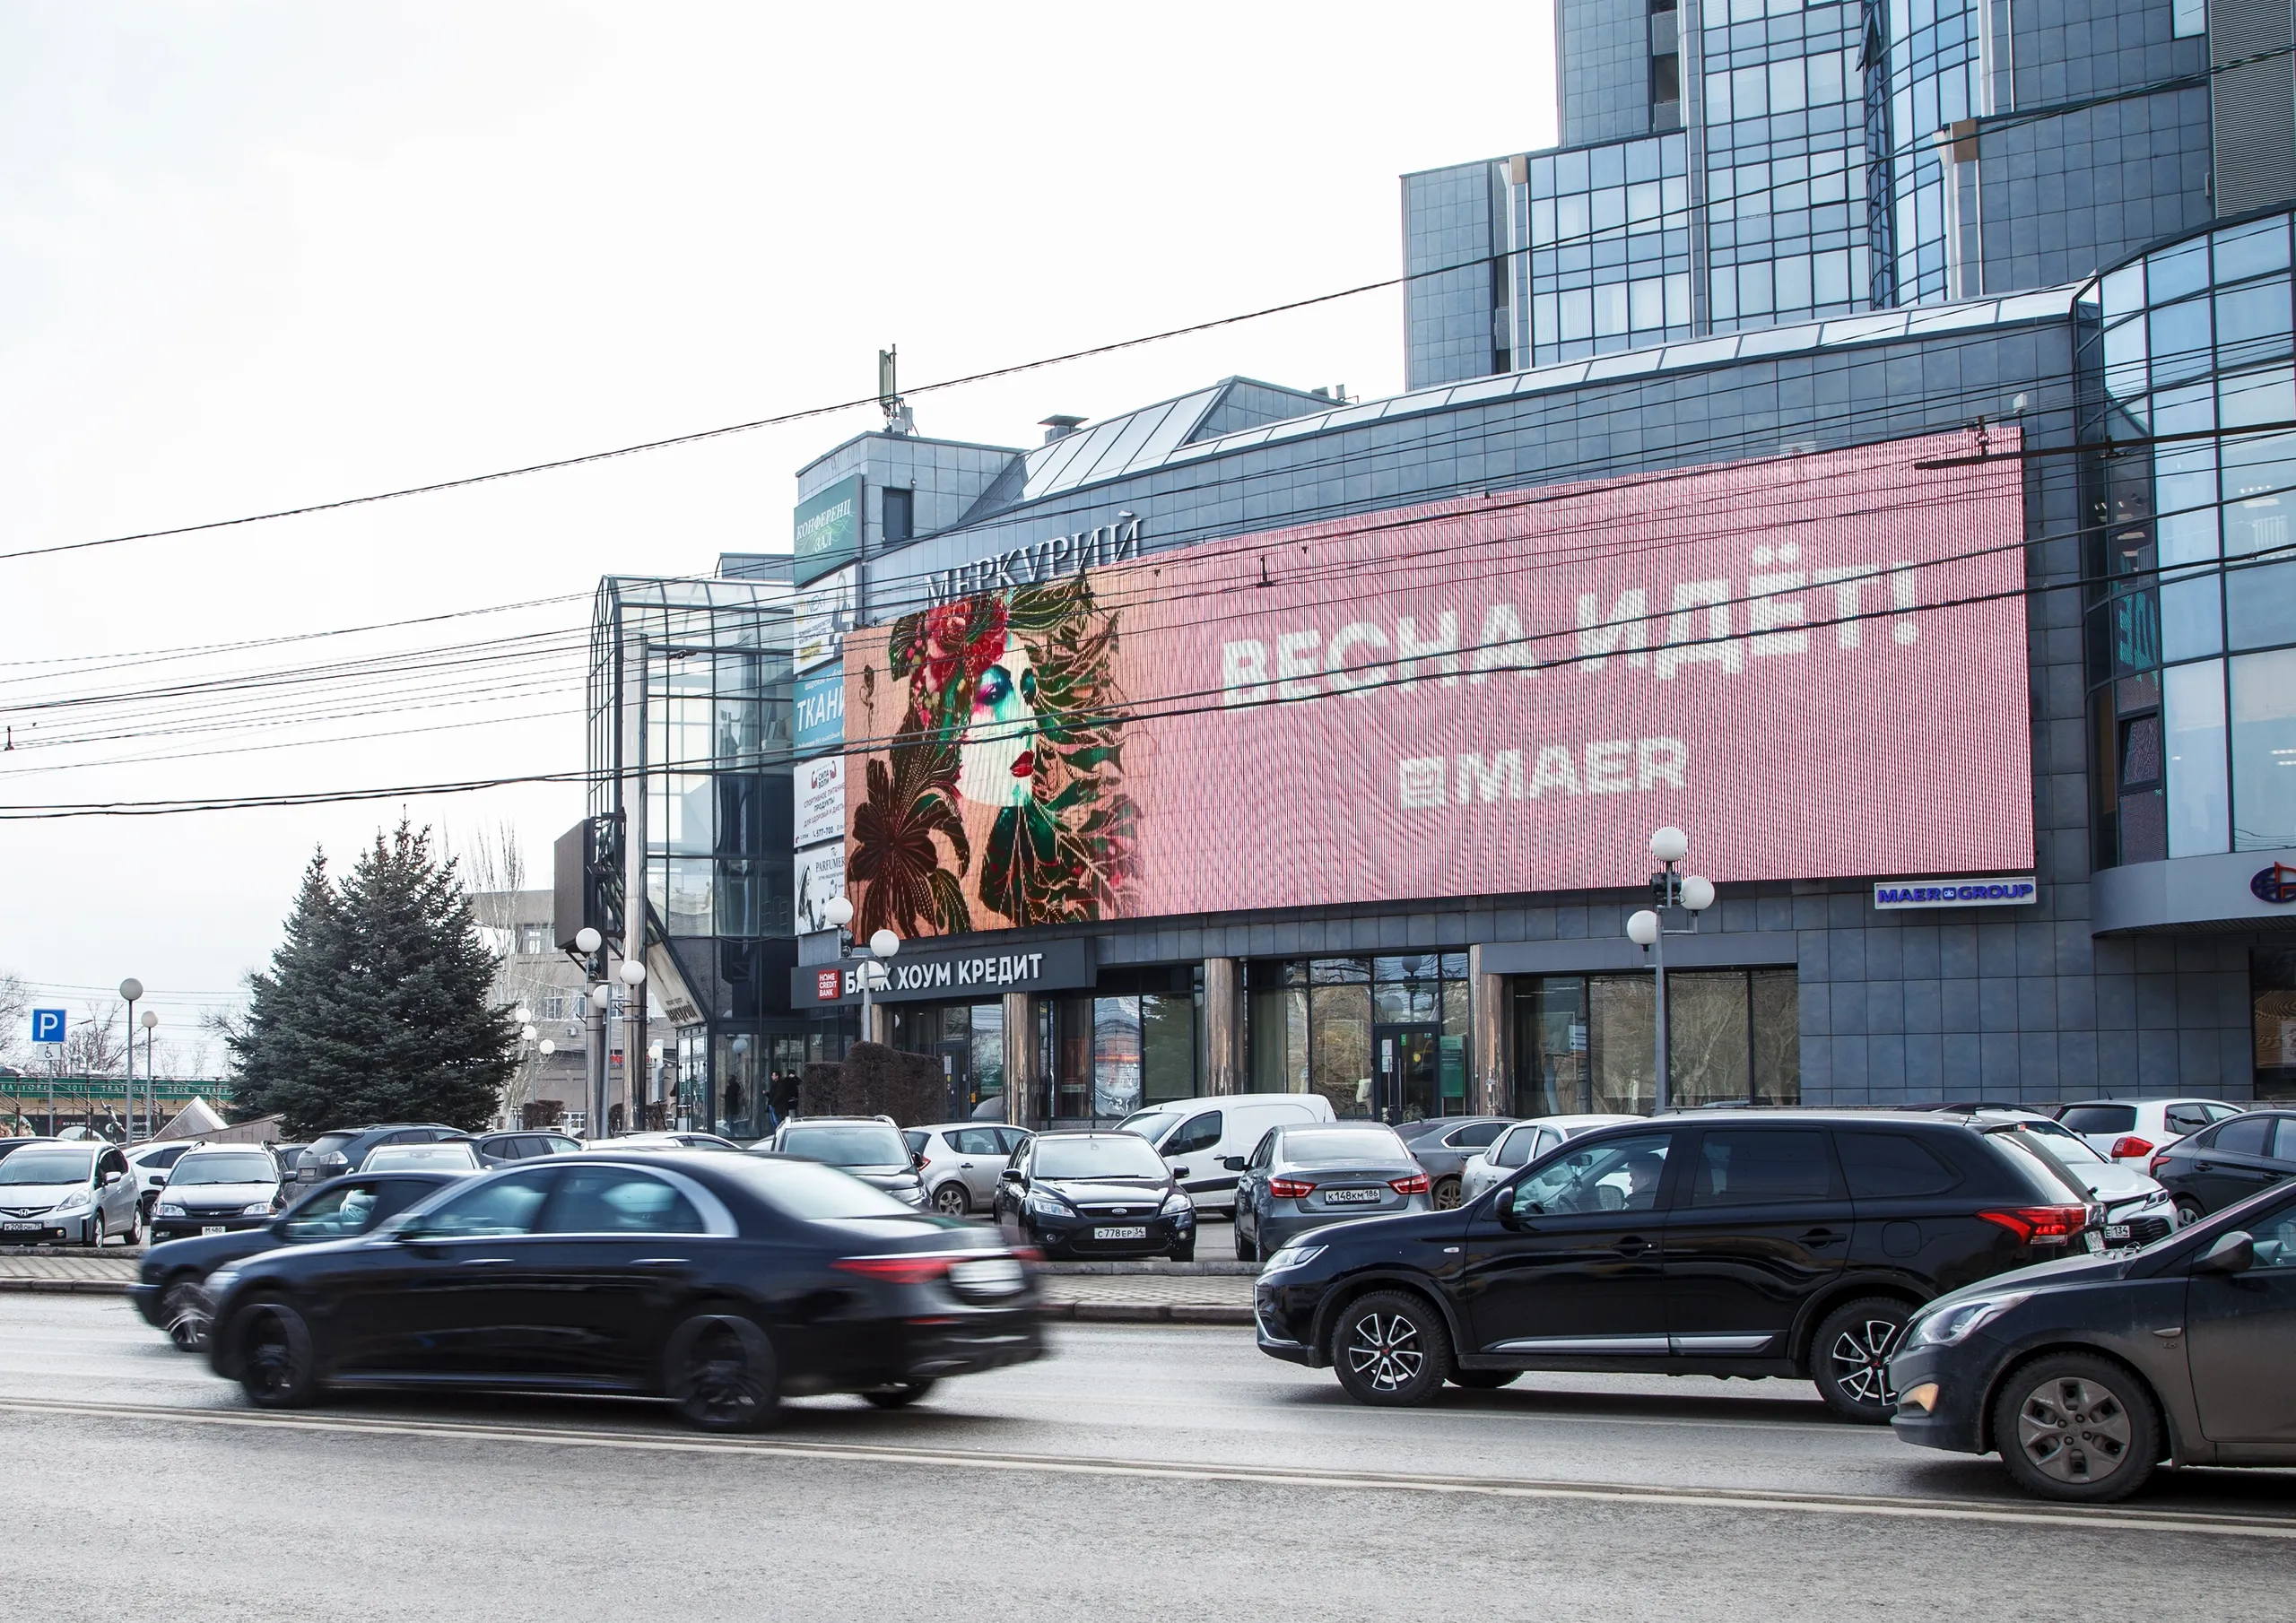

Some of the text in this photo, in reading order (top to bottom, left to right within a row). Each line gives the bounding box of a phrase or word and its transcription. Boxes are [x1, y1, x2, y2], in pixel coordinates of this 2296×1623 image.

[796, 499, 851, 541] КОНФЕРЕНЦ
[814, 531, 832, 553] ЗАЛ
[926, 510, 1142, 609] МЕРКУРИЙ
[1221, 542, 1919, 712] ВЕСНА ИДЁТ!
[1457, 736, 1686, 805] MAER
[813, 796, 836, 812] ПРОДУКТЫ
[815, 825, 834, 838] 577-700
[1877, 882, 2034, 904] MAER GROUP
[819, 973, 836, 982] HOME
[897, 962, 952, 990] ХОУМ
[958, 953, 1043, 985] КРЕДИТ
[819, 980, 838, 989] CREDIT
[819, 988, 834, 997] BANK
[39, 1012, 58, 1038] P
[1327, 1192, 1363, 1201] К148КМ
[1097, 1228, 1133, 1237] С778ЕР
[2112, 1226, 2129, 1234] 134
